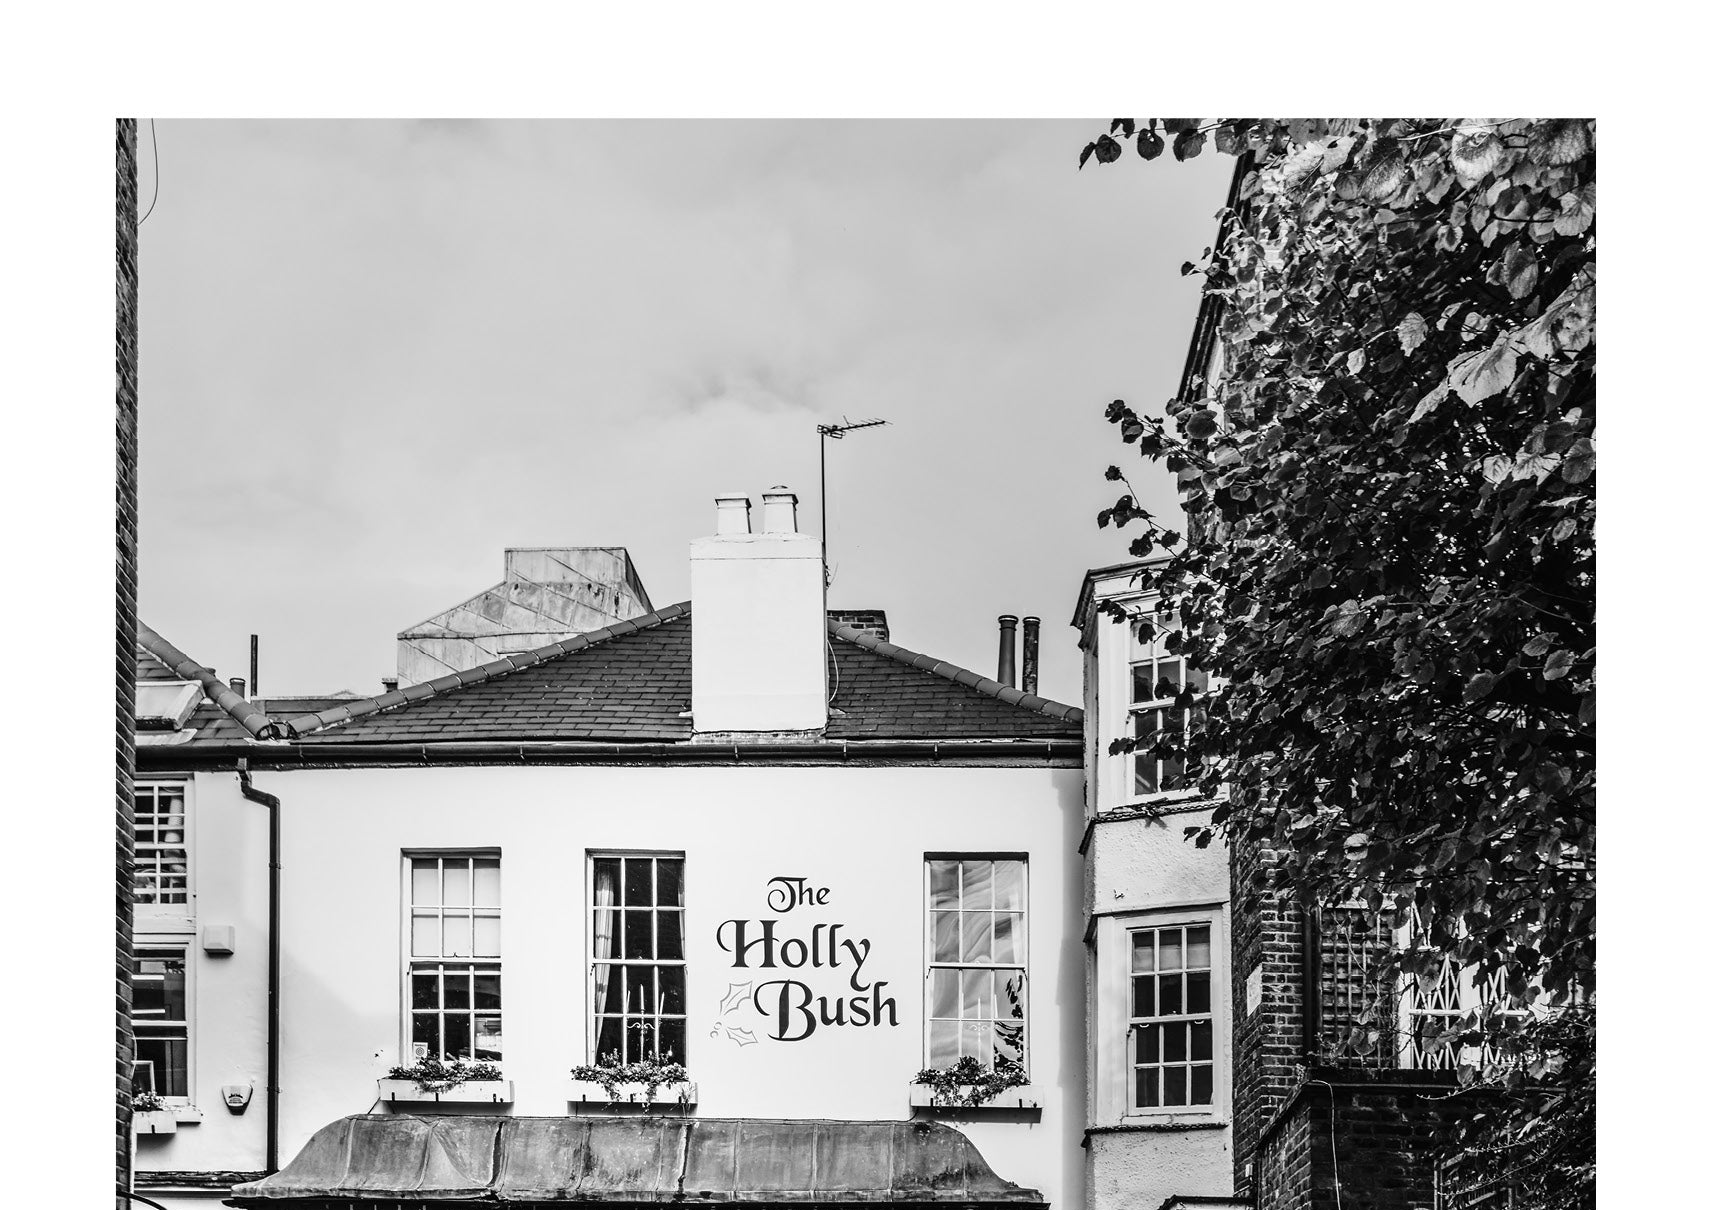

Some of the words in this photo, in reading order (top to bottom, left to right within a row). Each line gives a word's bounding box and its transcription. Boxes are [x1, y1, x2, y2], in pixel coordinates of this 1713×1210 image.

[766, 876, 831, 913] The
[716, 919, 871, 992] Holly
[753, 979, 900, 1042] Bush
